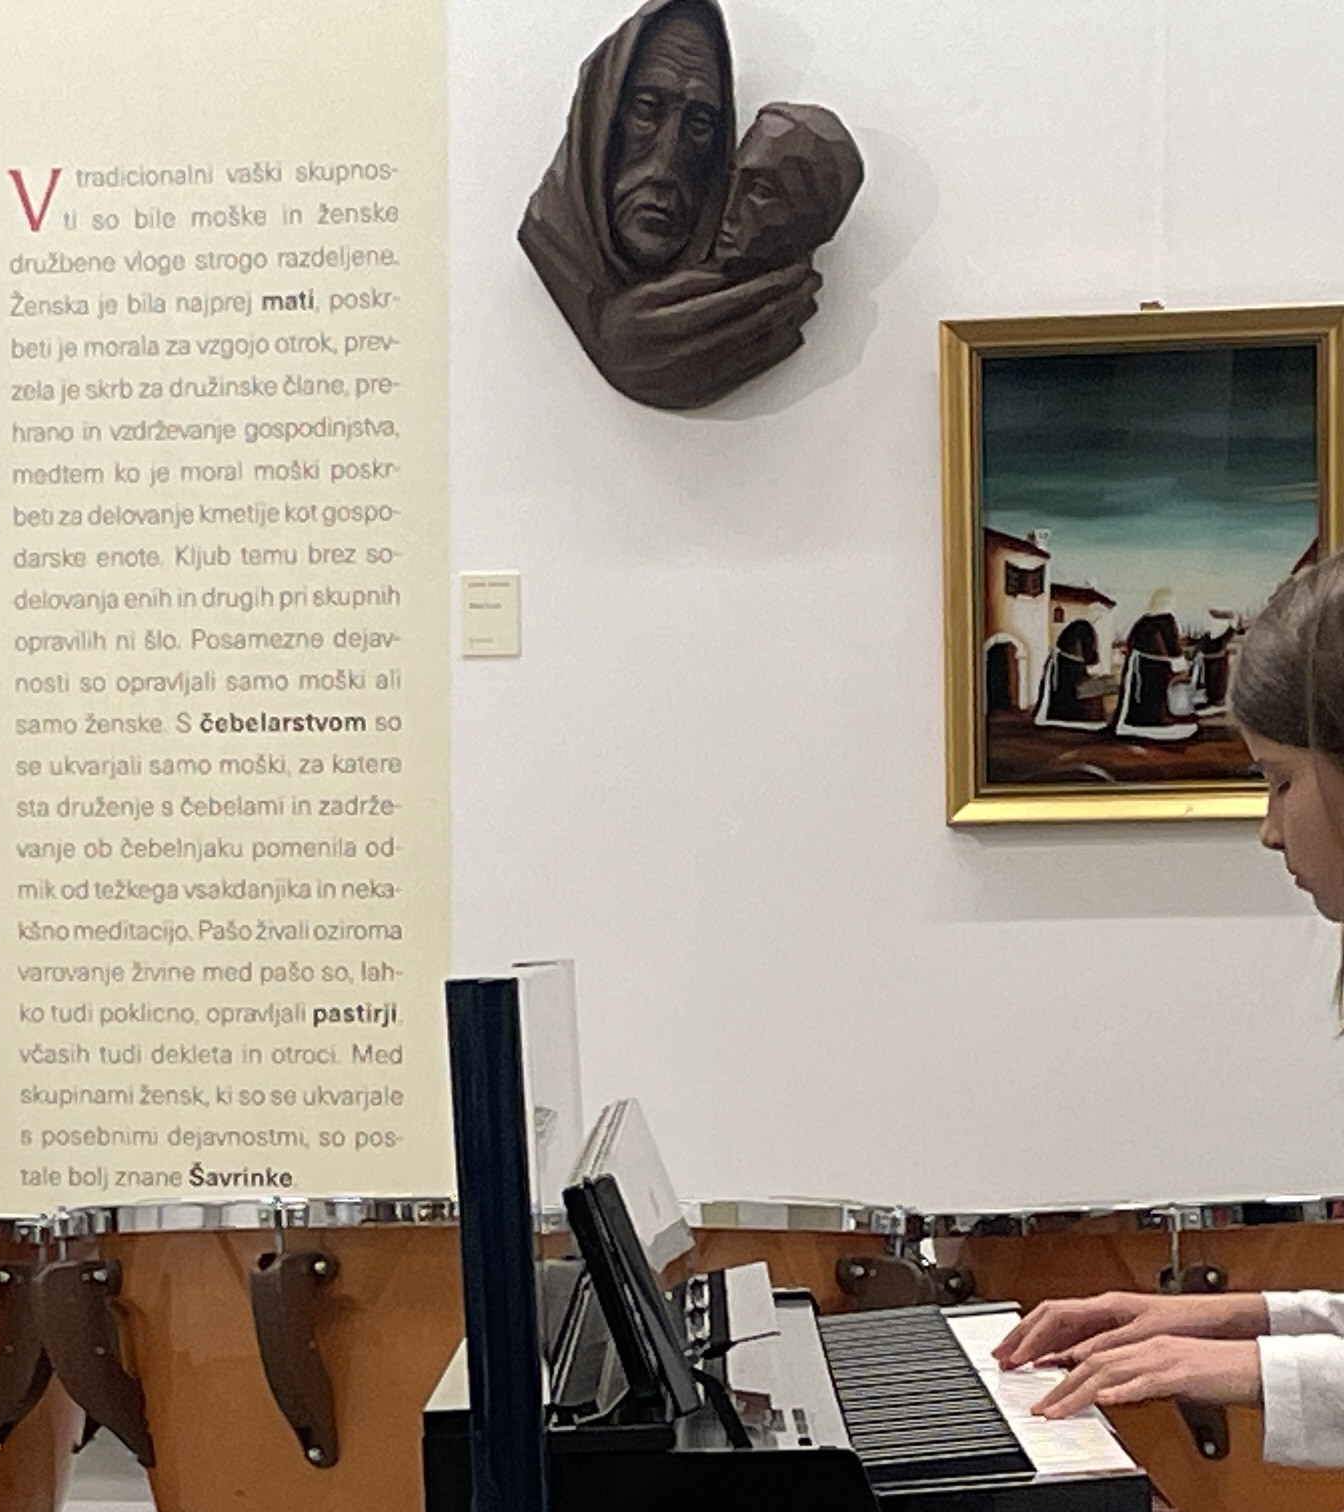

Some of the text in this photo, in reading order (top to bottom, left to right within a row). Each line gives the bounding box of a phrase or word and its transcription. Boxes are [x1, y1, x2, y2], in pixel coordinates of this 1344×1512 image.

[8, 167, 62, 233] V
[76, 162, 213, 185] tradicionalni
[226, 159, 282, 183] vaški
[64, 199, 398, 229] ti so bile moške in ženske
[9, 249, 115, 272] družbene
[124, 248, 185, 275] vloge
[195, 247, 267, 273] strogo
[9, 290, 89, 315] Ženska
[97, 291, 117, 318] je
[127, 290, 166, 313] bila
[176, 289, 252, 316] najprej
[11, 335, 51, 358] beti
[57, 334, 78, 361] je
[85, 333, 160, 356] morala
[166, 338, 191, 355] za
[195, 331, 269, 358] vzgojo
[11, 376, 54, 399] zela
[60, 376, 80, 403] je
[86, 375, 133, 398] skrb
[139, 380, 163, 397] za
[169, 373, 277, 396] družinske
[13, 419, 74, 441] hrano
[83, 419, 101, 441] in
[110, 416, 235, 444] vzdrževanje
[13, 461, 104, 484] medtem
[115, 460, 140, 482] ko
[150, 459, 170, 486] je
[181, 458, 242, 481] moral
[254, 457, 320, 480] moški
[13, 504, 54, 527] beti
[59, 509, 82, 527] za
[88, 503, 194, 530] delovanje
[199, 502, 280, 529] kmetije
[285, 501, 317, 523] kot
[13, 545, 86, 568] darske
[175, 543, 230, 570] Kljub
[241, 544, 297, 565] temu
[308, 542, 356, 565] brez
[14, 583, 401, 614] delovanja enih in drugih pri skupnih
[14, 628, 105, 655] opravilih
[116, 629, 135, 650] ni
[191, 626, 323, 649] Posamezne
[15, 667, 401, 696] nosti so opravljali samo moški ali
[16, 718, 77, 735] samo
[176, 711, 192, 734] S
[199, 710, 366, 733] čebelarstvom
[375, 715, 402, 732] so
[16, 759, 41, 776] se
[49, 753, 142, 780] ukvarjali
[149, 758, 211, 775] samo
[299, 757, 324, 775] za
[332, 752, 402, 774] katere
[17, 796, 49, 818] sta
[57, 794, 154, 822] druženje
[161, 800, 173, 817] s
[180, 794, 284, 817] čebelami
[291, 795, 311, 817] in
[17, 836, 75, 863] vanje
[84, 836, 112, 859] ob
[120, 835, 243, 863] čebelnjaku
[252, 835, 356, 862] pomenila
[18, 878, 56, 900] mik
[61, 878, 89, 900] od
[95, 877, 178, 904] težkega
[184, 877, 311, 904] vsakdanjika
[317, 878, 336, 899] in
[18, 918, 69, 941] kšno
[198, 917, 251, 941] Pašo
[255, 917, 309, 940] živali
[314, 919, 403, 940] oziroma
[18, 960, 124, 987] varovanje
[131, 959, 195, 983] živine
[202, 960, 252, 982] med
[260, 959, 314, 986] pašo
[19, 1001, 44, 1024] ko
[51, 1001, 93, 1024] tudi
[206, 1001, 306, 1028] opravljali
[19, 1042, 90, 1065] včasih
[100, 1042, 141, 1065] tudi
[151, 1042, 232, 1065] dekleta
[242, 1043, 262, 1064] in
[352, 1041, 403, 1064] Med
[20, 1084, 133, 1111] skupinami
[216, 1083, 232, 1106] ki
[239, 1088, 265, 1106] so
[271, 1088, 296, 1106] se
[303, 1083, 404, 1110] ukvarjale
[20, 1130, 33, 1148] s
[41, 1125, 158, 1152] posebnimi
[319, 1130, 345, 1147] so
[21, 1166, 61, 1189] tale
[69, 1166, 108, 1193] bolj
[115, 1171, 182, 1188] znane
